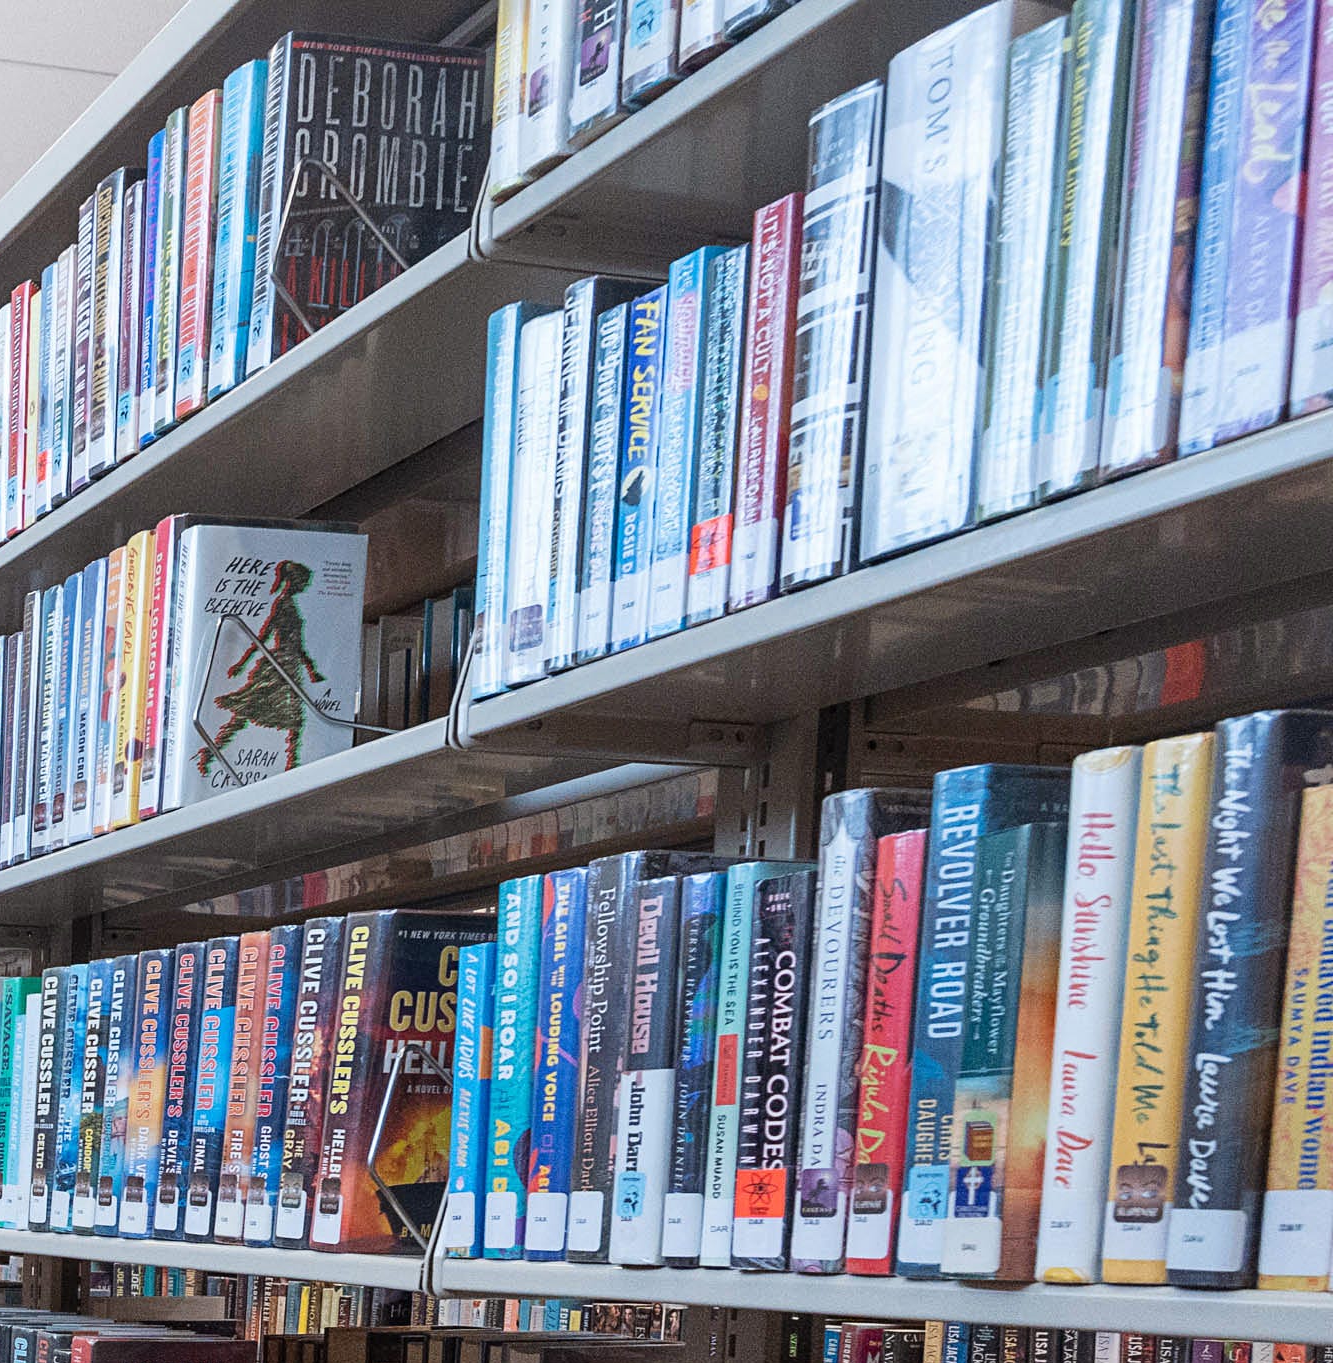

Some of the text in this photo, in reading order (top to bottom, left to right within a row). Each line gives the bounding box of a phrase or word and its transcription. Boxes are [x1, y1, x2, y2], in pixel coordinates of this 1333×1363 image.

[297, 52, 479, 140] DEBORAH
[294, 127, 473, 214] CROMBIE
[76, 211, 94, 342] NOBODY'S HERO
[627, 300, 661, 464] FAN SERVICE
[215, 577, 265, 597] IS THE
[225, 555, 275, 577] HERE
[204, 598, 268, 618] BEEHIVE
[234, 748, 280, 766] SARAH
[1149, 822, 1175, 876] Last
[1201, 741, 1253, 1030] The Night We Lost Him
[503, 892, 522, 950] AND
[552, 883, 571, 961] THE GIRL
[927, 803, 980, 1040] REVOLVER ROAD
[1133, 892, 1175, 965] Thing
[502, 956, 519, 987] SO
[587, 887, 616, 1054] Fellowship Point
[631, 895, 664, 1055] Devil House
[818, 884, 844, 1041] DEVOURERS
[1138, 971, 1168, 1008] He
[289, 927, 326, 1103] CLIVE CUSSLER
[329, 925, 370, 1115] CLIVE CUSSLER'S
[497, 1009, 518, 1081] ROAR
[1132, 1011, 1164, 1077] Told
[541, 992, 564, 1123] LOUDING VOICE
[762, 950, 797, 1169] COMBAT CODES
[628, 1081, 647, 1128] John
[493, 1119, 511, 1166] ABI
[1126, 1336, 1142, 1363] LISA
